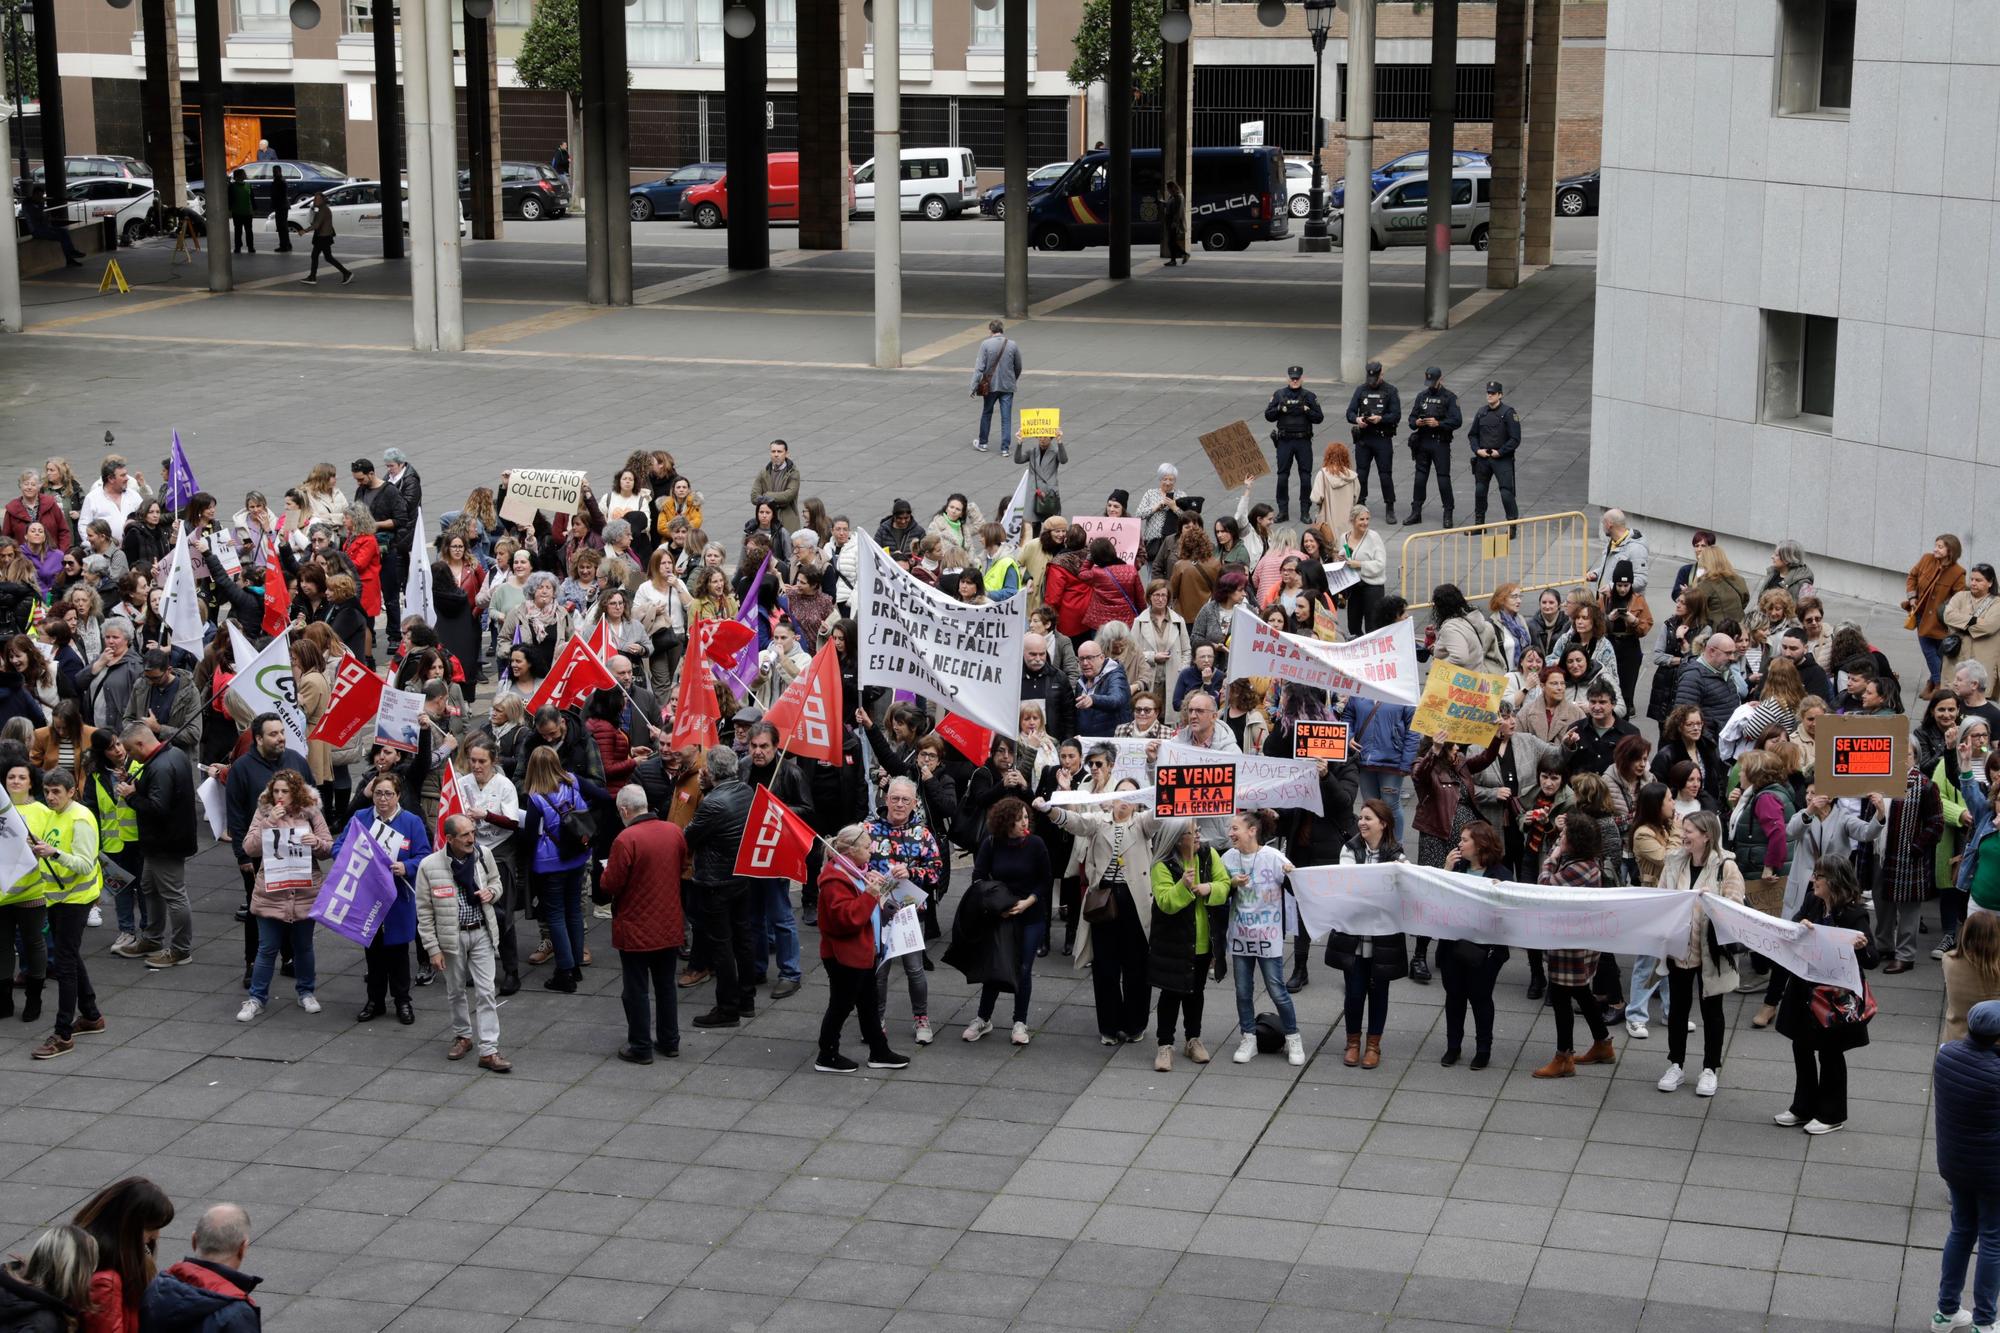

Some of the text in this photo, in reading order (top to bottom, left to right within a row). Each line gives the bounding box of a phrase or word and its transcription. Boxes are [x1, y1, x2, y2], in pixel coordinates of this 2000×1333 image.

[520, 471, 580, 488] CONVENIO
[1111, 521, 1123, 531] LA
[934, 628, 951, 646] ES
[869, 654, 885, 671] ES
[888, 655, 905, 673] LO
[1447, 685, 1491, 710] VENDE
[1297, 724, 1346, 738] SE VENDE
[1313, 739, 1335, 748] ERA
[1836, 738, 1890, 751] SE VENDE
[1158, 766, 1233, 786] SE VENDE
[1189, 787, 1224, 801] ERA
[1175, 801, 1232, 814] LA GERENTE
[361, 900, 384, 938] ASTURIAS
